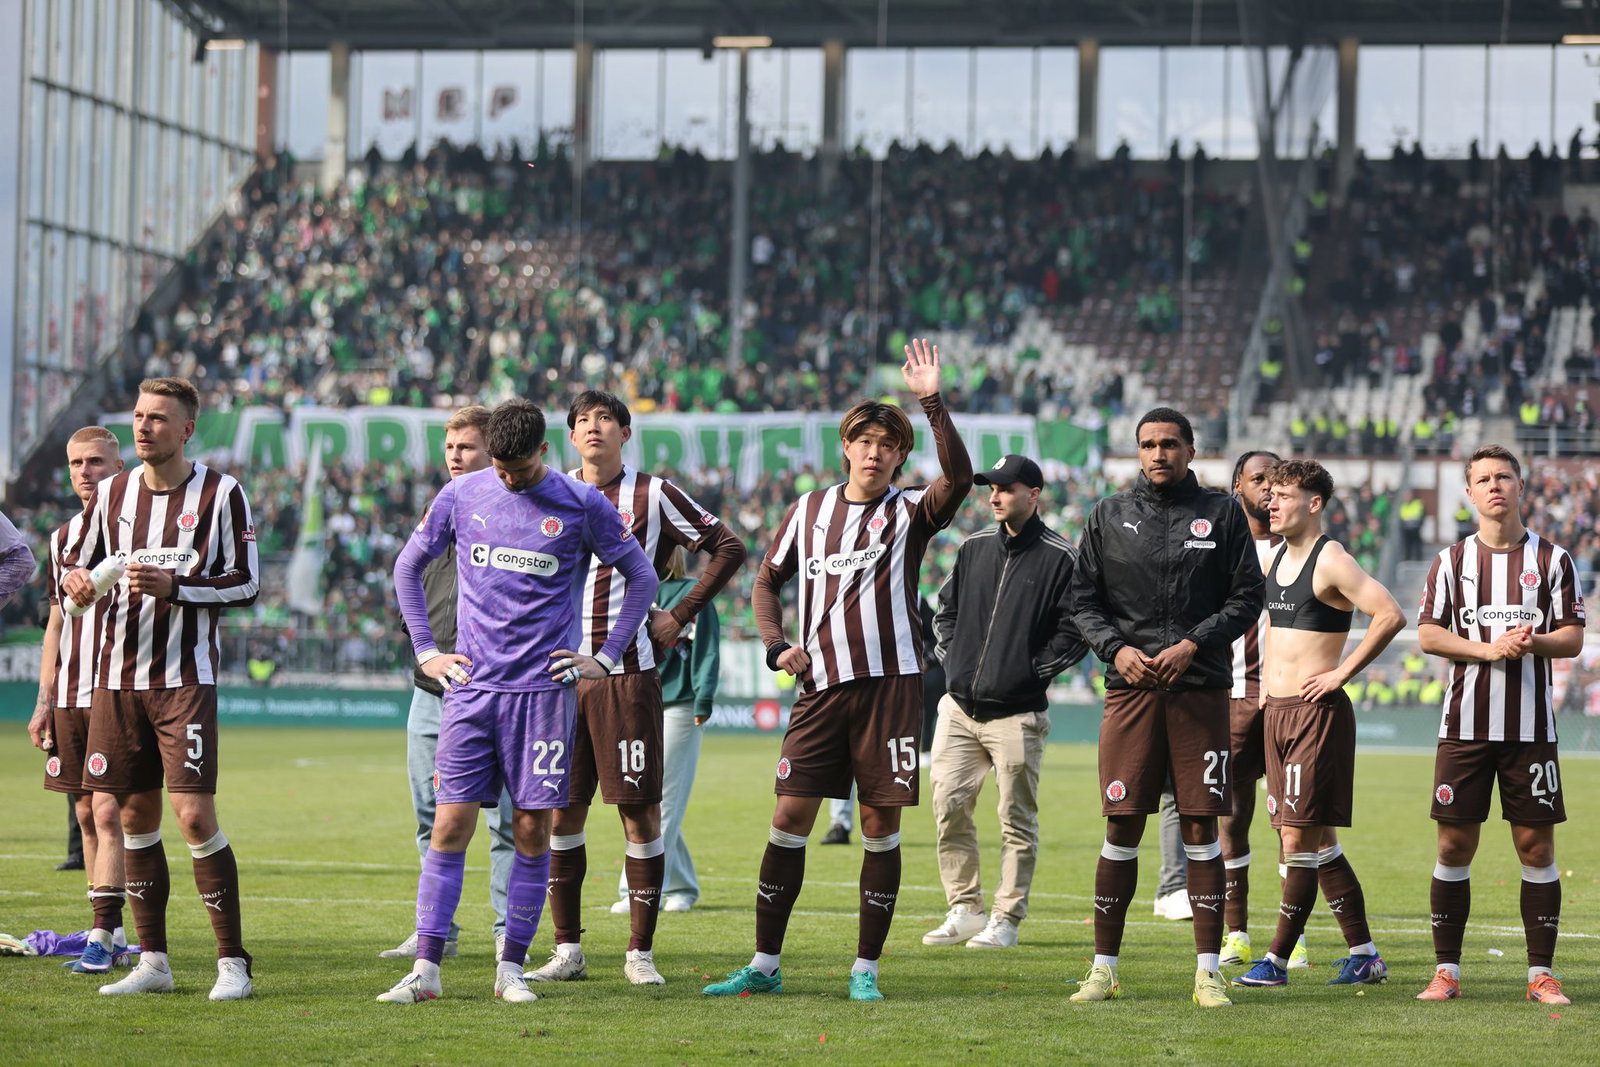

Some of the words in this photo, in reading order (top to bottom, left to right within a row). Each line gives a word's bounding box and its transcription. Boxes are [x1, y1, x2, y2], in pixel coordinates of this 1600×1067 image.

[138, 551, 192, 565] congstar
[497, 552, 553, 570] congstar
[1268, 602, 1295, 611] CATAPULT
[1483, 609, 1536, 621] congstar
[186, 724, 203, 760] 5
[532, 739, 565, 775] 22
[619, 739, 645, 772] 18
[888, 737, 916, 772] 15
[1203, 750, 1229, 784] 27
[1285, 763, 1301, 796] 11
[1529, 760, 1558, 796] 20
